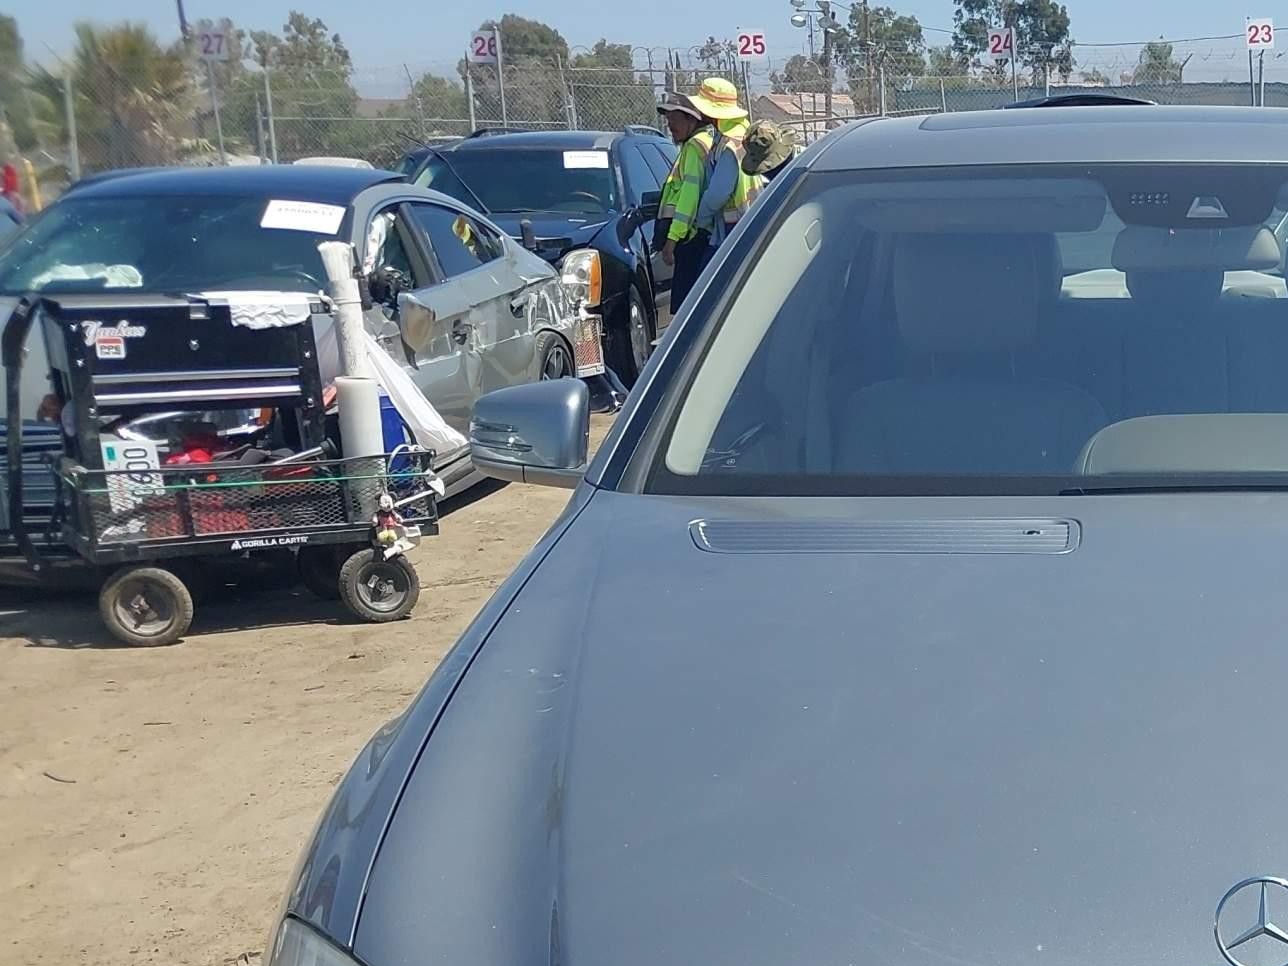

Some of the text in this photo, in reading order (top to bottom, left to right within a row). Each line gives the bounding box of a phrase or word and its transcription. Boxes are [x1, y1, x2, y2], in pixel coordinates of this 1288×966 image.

[201, 33, 224, 55] 27
[991, 34, 1012, 53] 24
[1248, 25, 1272, 44] 23
[739, 34, 766, 55] 25
[241, 538, 278, 549] GORILLA
